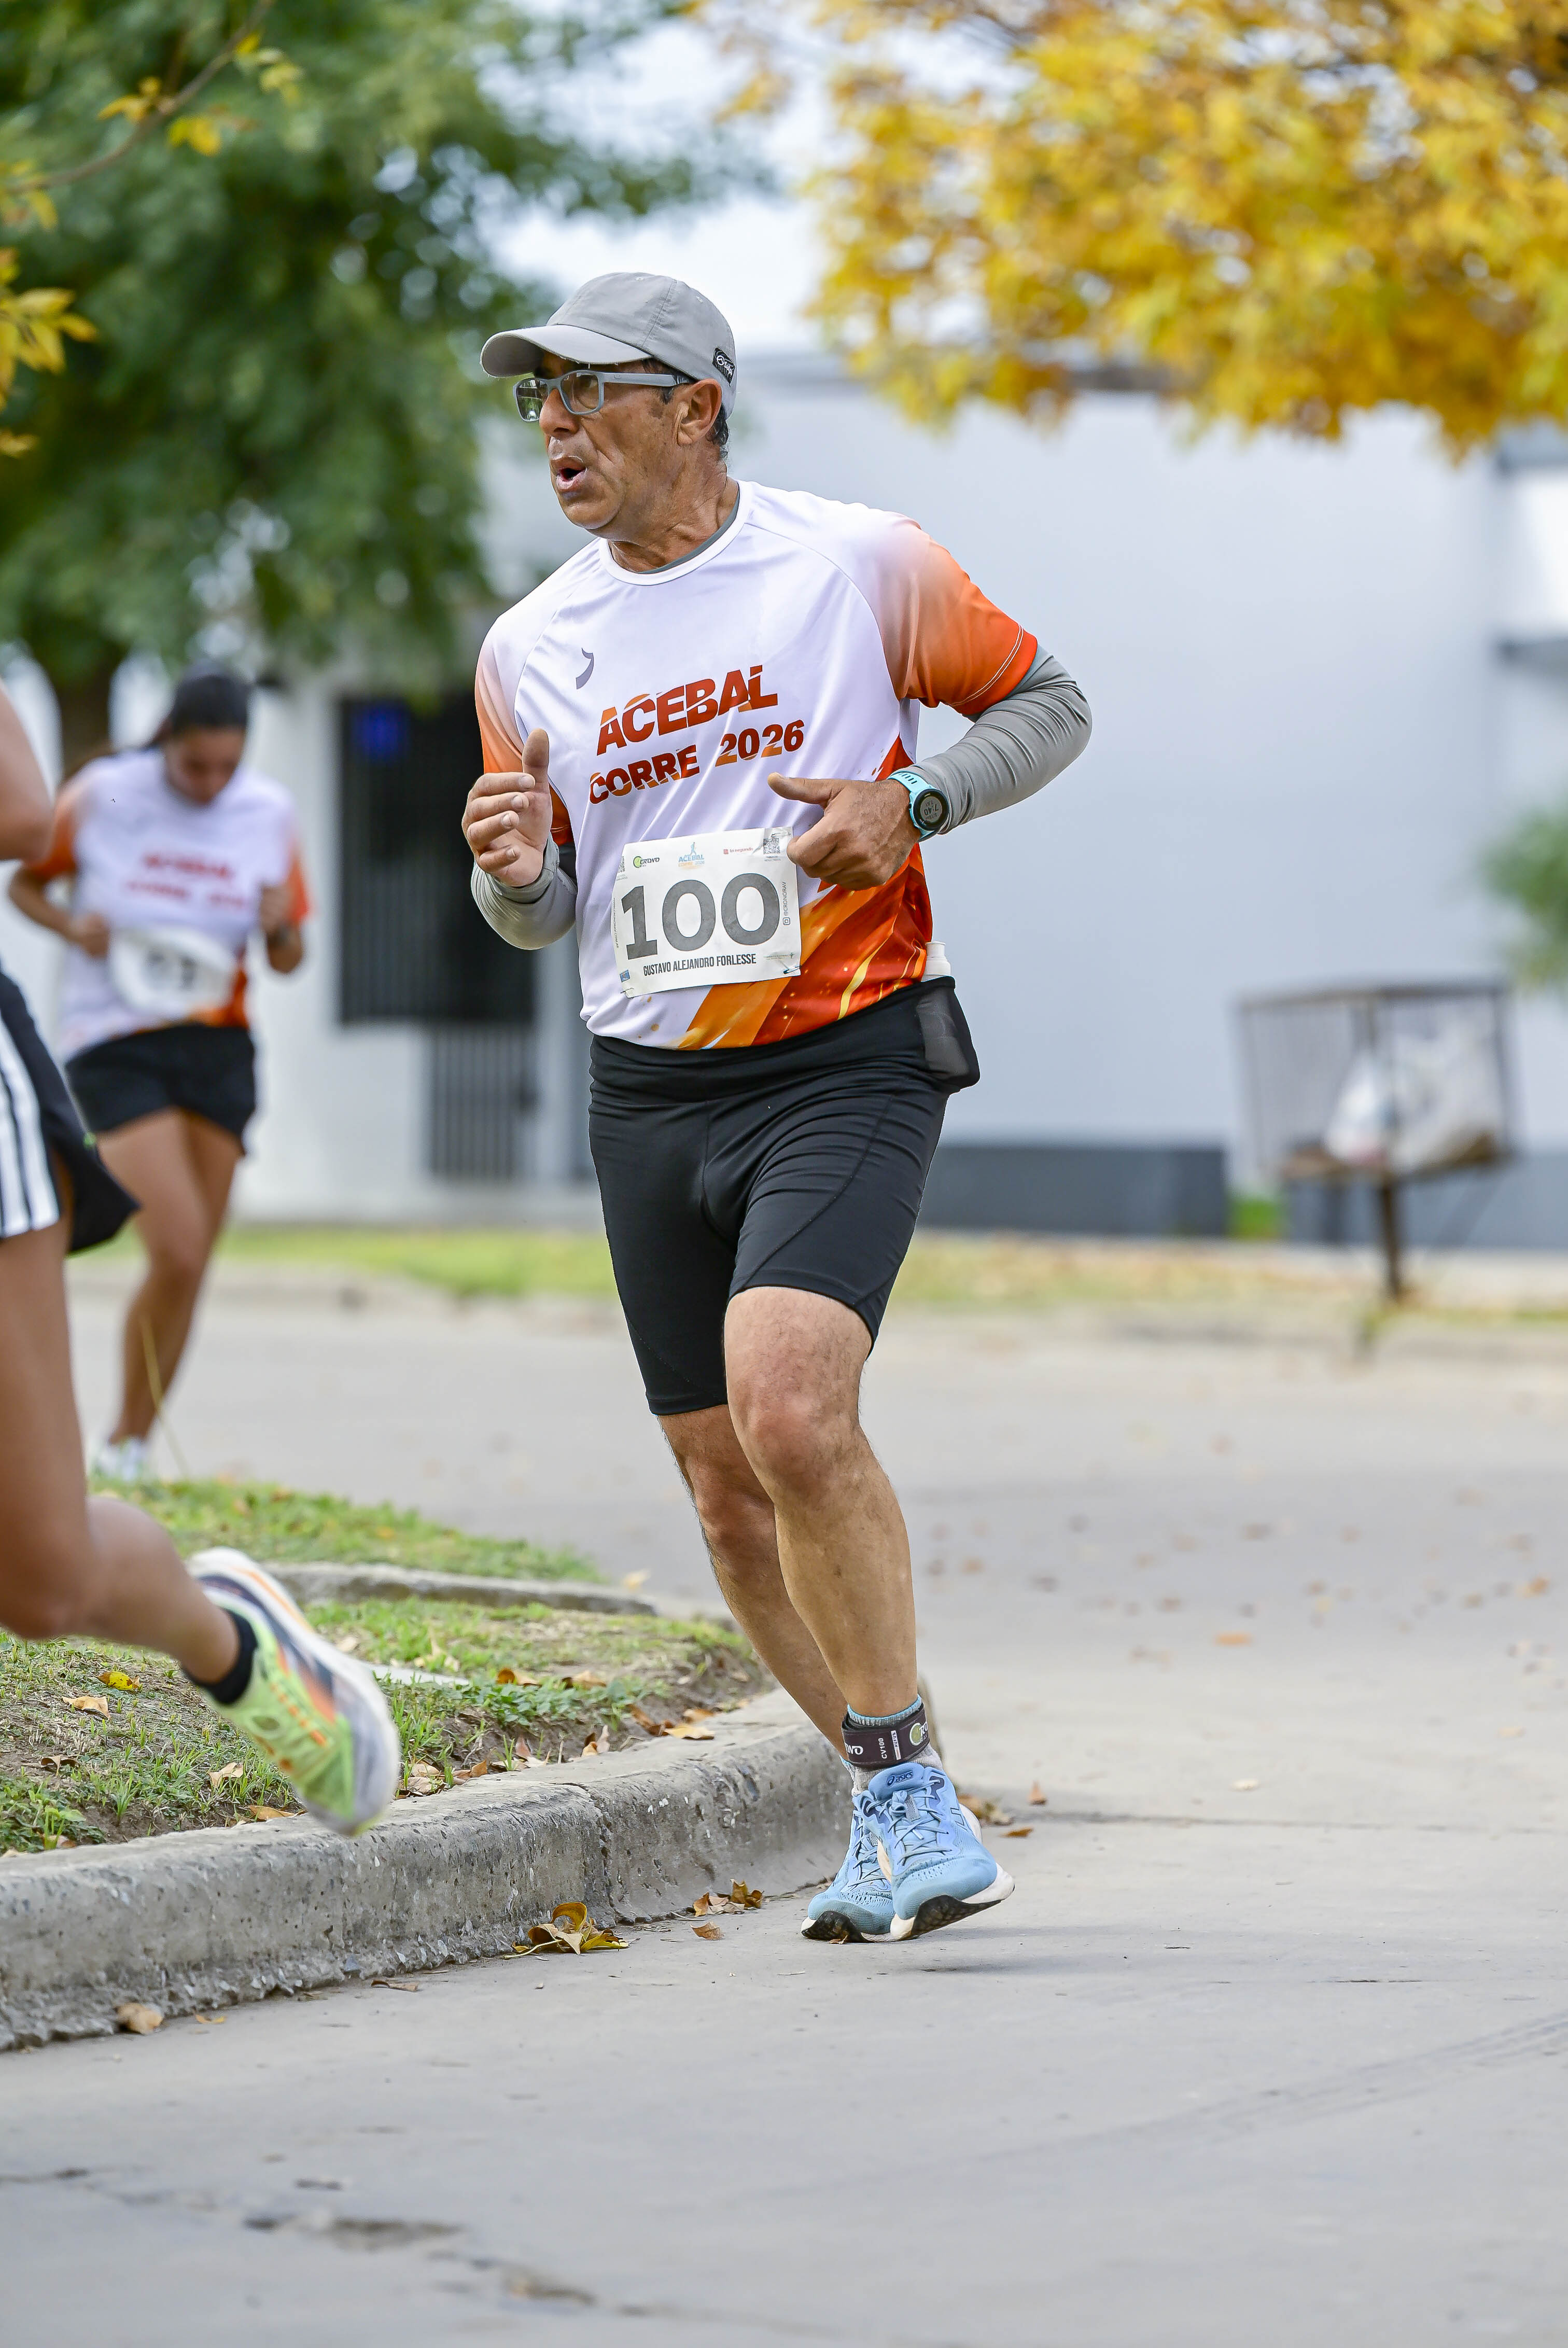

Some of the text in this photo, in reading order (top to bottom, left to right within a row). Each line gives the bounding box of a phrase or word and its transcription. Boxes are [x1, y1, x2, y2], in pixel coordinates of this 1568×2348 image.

[596, 664, 778, 756] ACEBAL
[589, 719, 805, 804] CORRE 2026
[621, 873, 780, 960] 100
[643, 962, 671, 976] GUSTAVO
[673, 957, 715, 971] ALEJANDRO
[717, 953, 757, 967] FORLESSE
[878, 1738, 887, 1759] CV100
